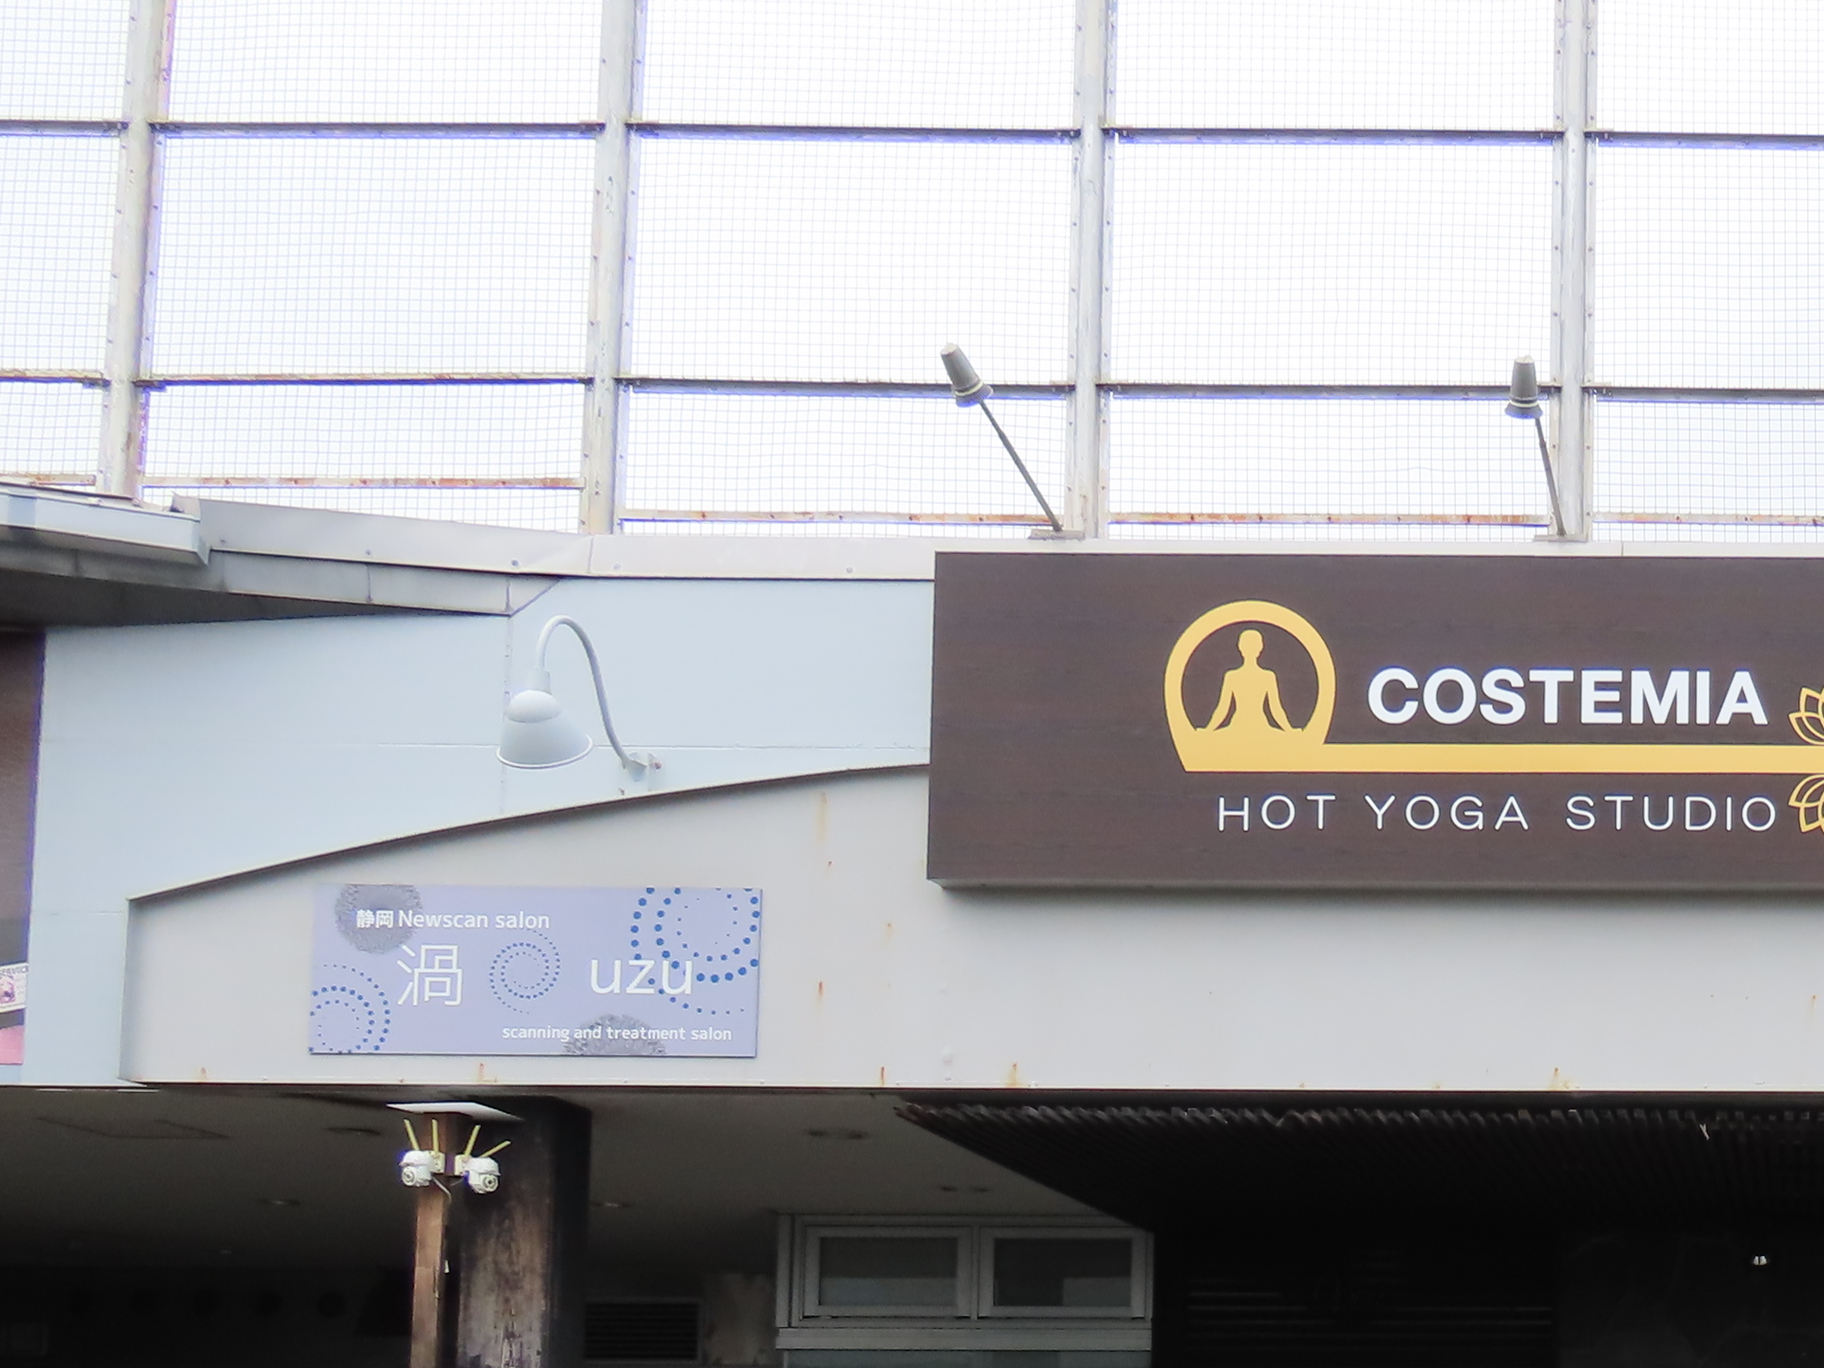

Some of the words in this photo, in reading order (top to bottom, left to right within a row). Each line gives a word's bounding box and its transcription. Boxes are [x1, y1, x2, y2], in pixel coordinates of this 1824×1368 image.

[1367, 667, 1769, 725] COSTEMIA
[1219, 795, 1336, 832] HOT
[1364, 795, 1530, 832] YOGA
[1565, 795, 1777, 832] STUDIO
[356, 909, 394, 928] 静岡
[398, 909, 489, 928] Newscan
[495, 910, 550, 928] salon
[396, 944, 463, 1006] 渦
[590, 958, 694, 995] uzu
[502, 1025, 570, 1043] scanning
[574, 1025, 602, 1040] and
[606, 1026, 687, 1041] treatment
[690, 1026, 733, 1041] salon
